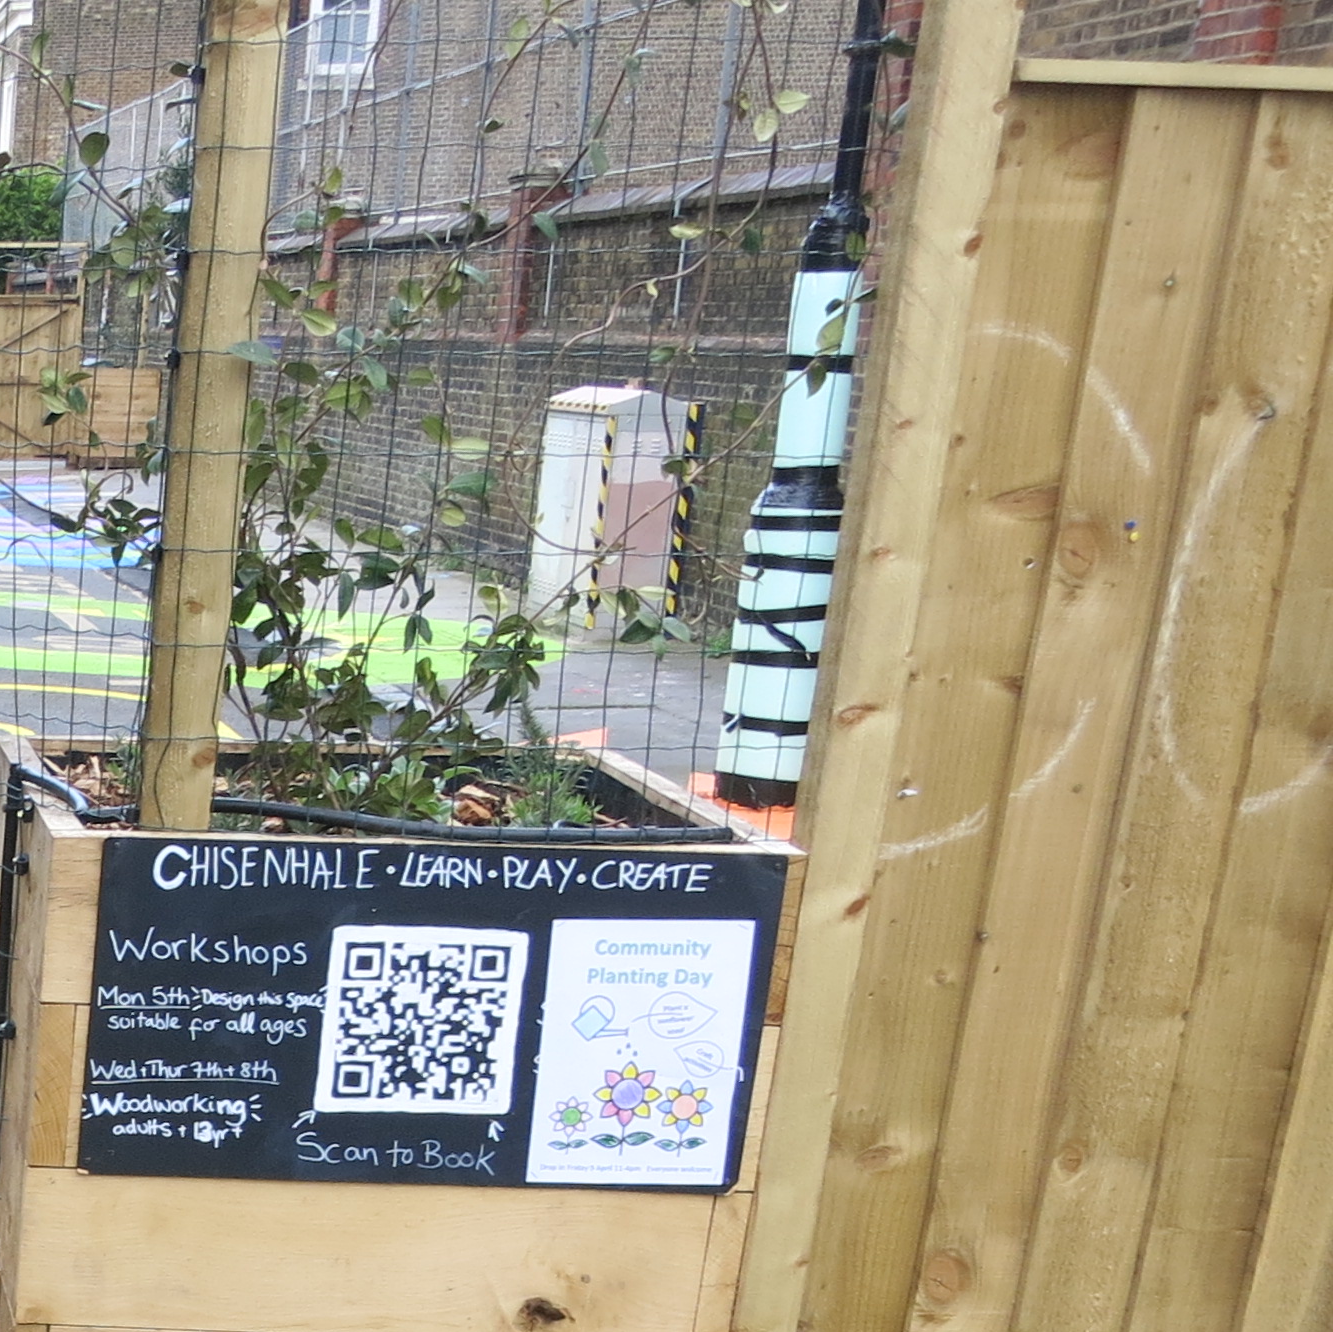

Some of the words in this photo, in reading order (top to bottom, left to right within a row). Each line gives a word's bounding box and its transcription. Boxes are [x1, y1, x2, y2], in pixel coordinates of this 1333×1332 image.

[152, 844, 381, 890] CHISENHALE
[399, 851, 483, 889] LEARN
[502, 855, 577, 894] PLAY
[591, 859, 714, 893] CREATE
[108, 926, 308, 977] Workshops
[594, 938, 711, 960] Community
[586, 967, 669, 988] Planting
[674, 968, 713, 988] Day
[97, 985, 145, 1007] Mon
[152, 986, 191, 1006] 5th
[200, 988, 255, 1012] Design
[257, 990, 284, 1006] this
[107, 1012, 183, 1032] suitable
[188, 1018, 221, 1041] for
[225, 1011, 256, 1035] all
[260, 1018, 308, 1045] ages
[240, 1059, 278, 1082] 8th
[90, 1091, 248, 1127] Woodworking
[112, 1118, 173, 1138] adults
[295, 1130, 380, 1167] Scan
[386, 1139, 415, 1168] to
[417, 1139, 497, 1178] Book
